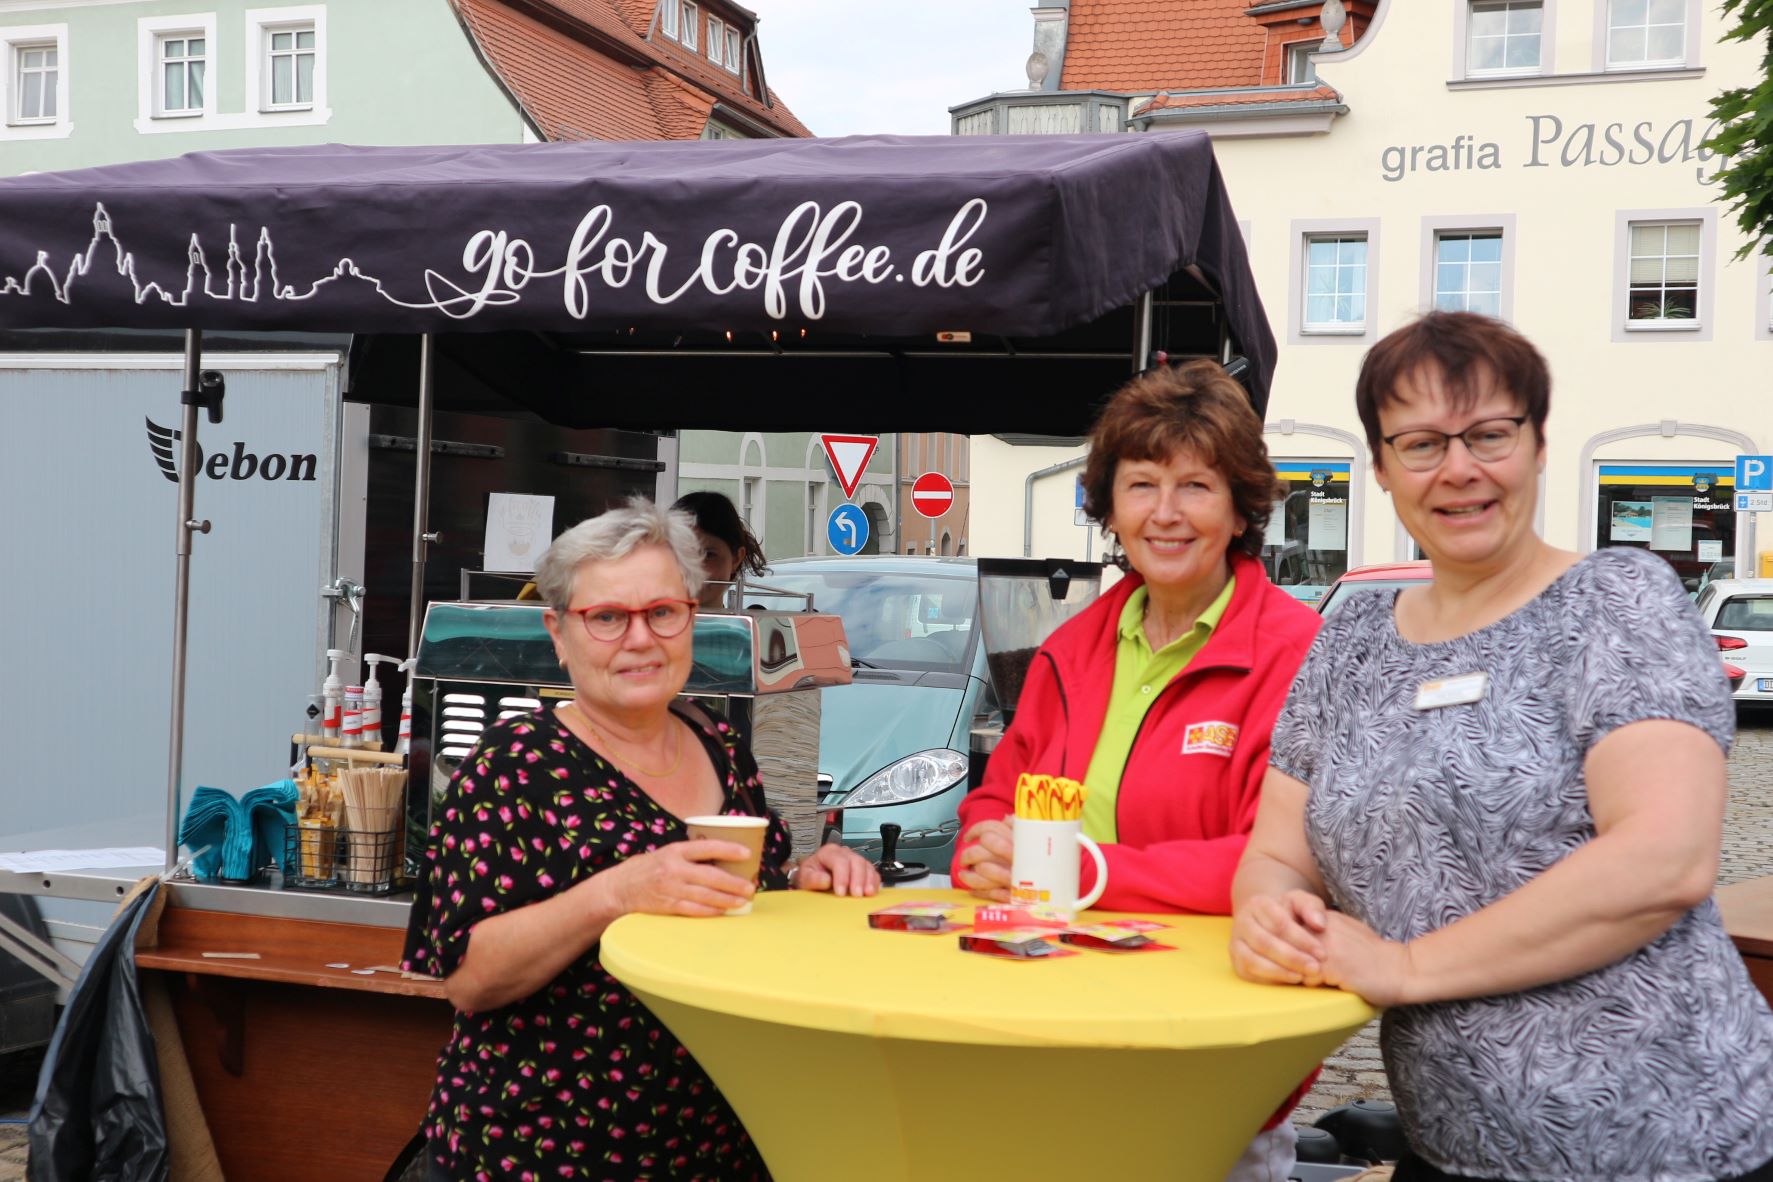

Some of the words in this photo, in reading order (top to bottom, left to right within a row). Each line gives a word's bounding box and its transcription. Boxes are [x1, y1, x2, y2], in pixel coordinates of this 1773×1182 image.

[1381, 135, 1501, 182] grafia
[1523, 114, 1748, 186] Passag
[428, 230, 534, 319] go
[563, 204, 698, 319] for
[1744, 460, 1765, 486] P
